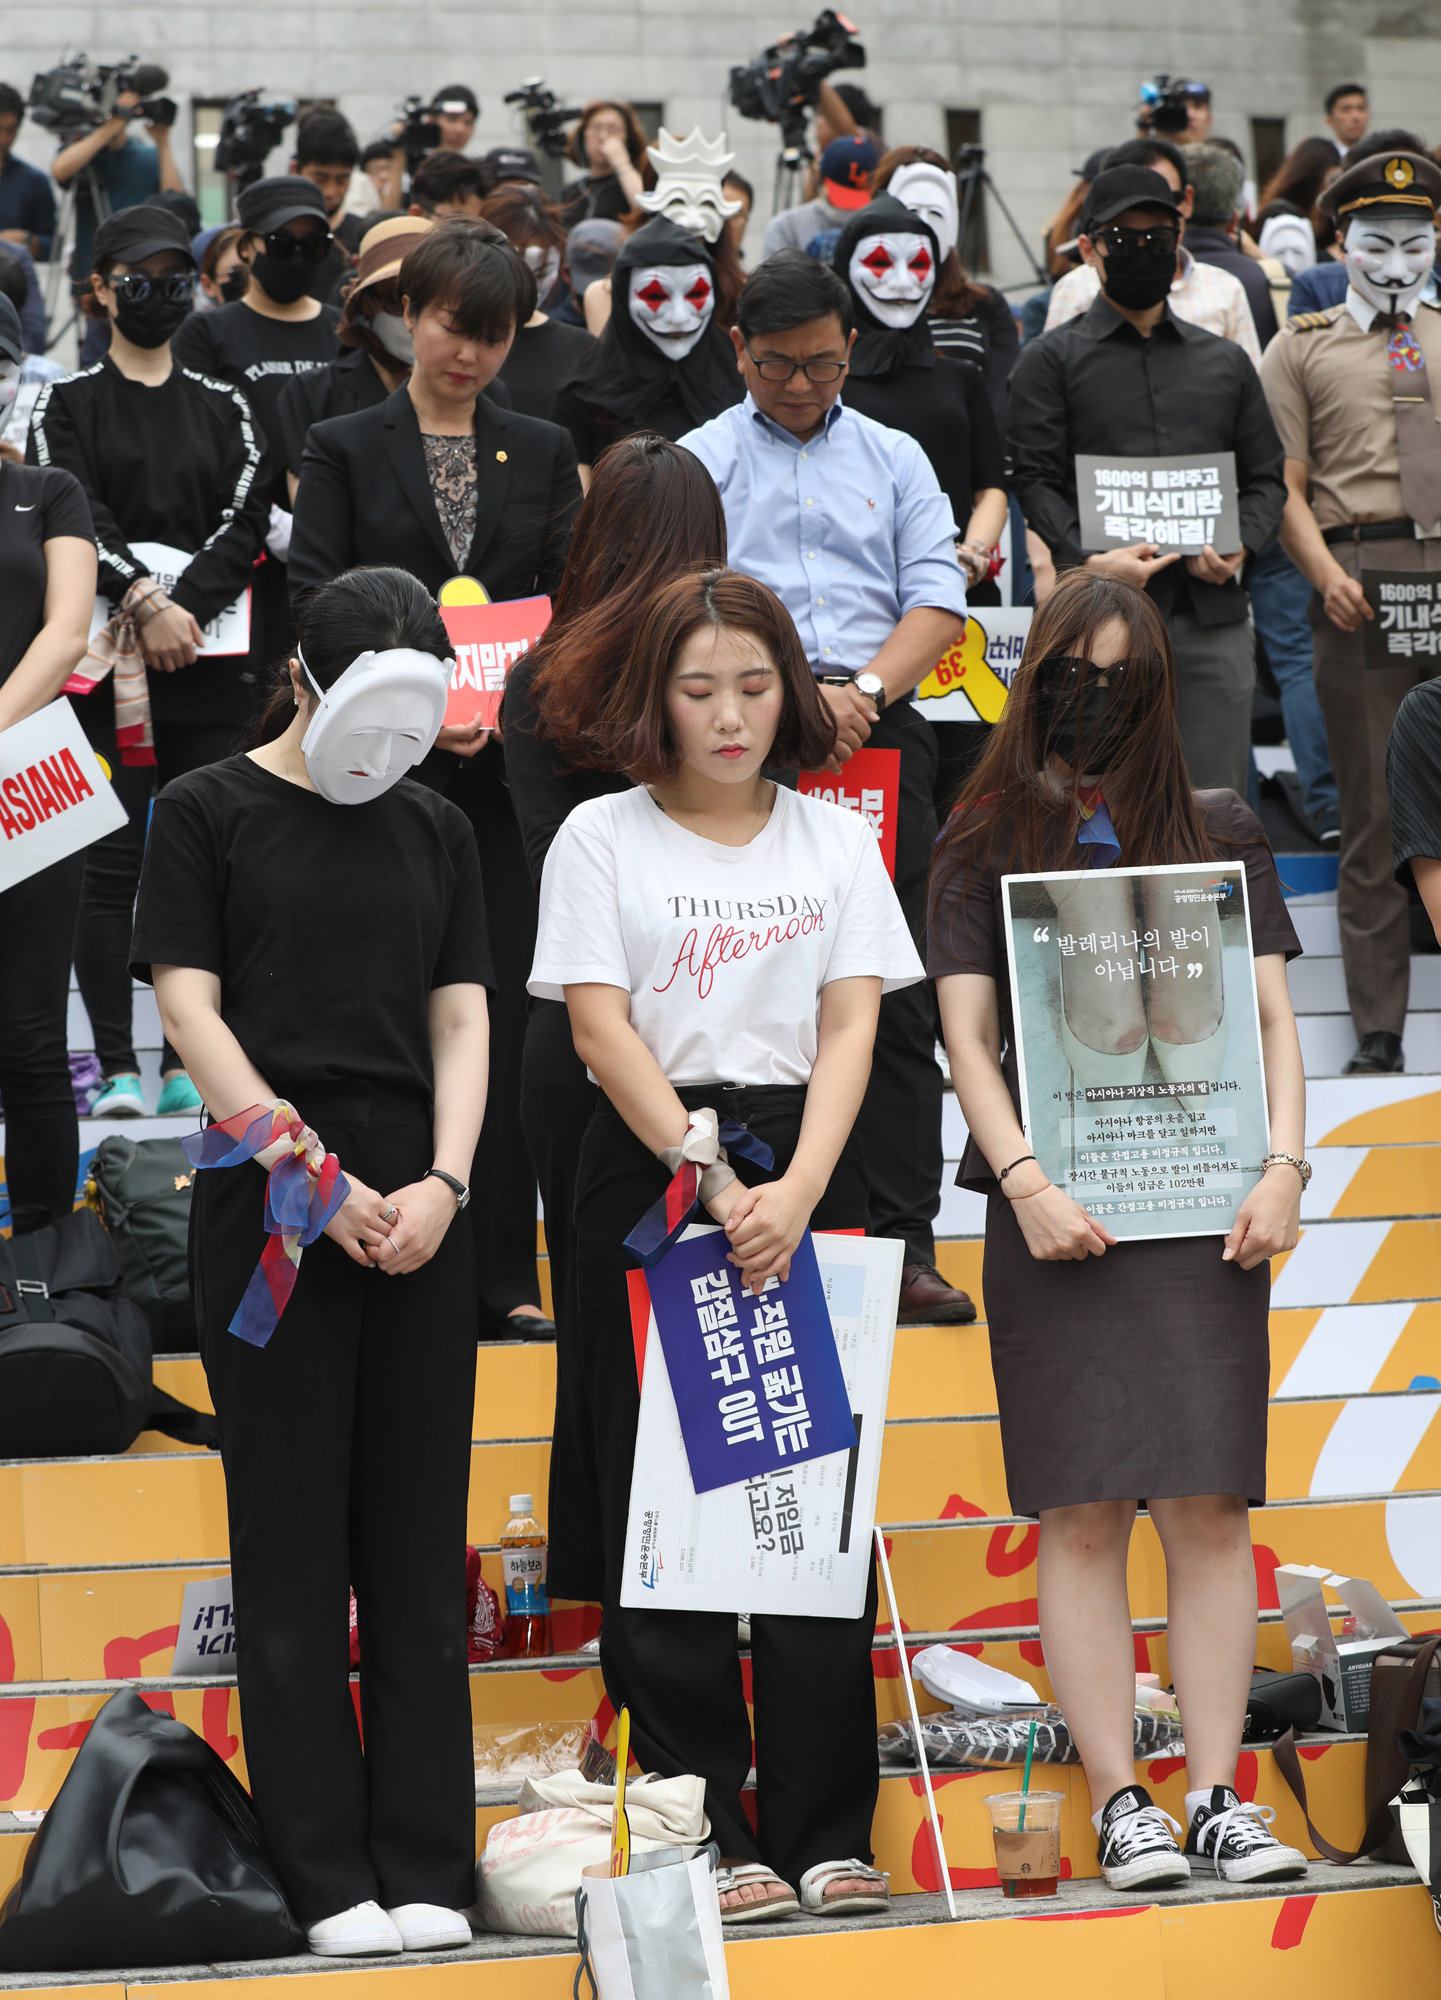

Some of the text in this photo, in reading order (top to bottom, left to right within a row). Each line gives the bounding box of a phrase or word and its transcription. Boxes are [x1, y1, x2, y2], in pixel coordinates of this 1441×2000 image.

[1094, 468, 1148, 489] 1600억
[1095, 488, 1223, 517] 기내식대란
[1104, 515, 1216, 545] 즉각해결!
[1379, 583, 1433, 602] 1600억
[1387, 630, 1441, 657] 즉각
[0, 747, 95, 840] ASIANA
[667, 894, 828, 921] THURSDAY
[1056, 928, 1161, 957] 발레리나의
[1169, 926, 1210, 950] 발이
[652, 913, 826, 999] Afternoon
[1094, 955, 1180, 983] 아닙니다
[1052, 1080, 1241, 1103] 이 발은 아시아나 지상직 노동자의 발 입니다.
[1095, 1111, 1207, 1129] 아시아나 항공의 옷을 입고
[1086, 1125, 1217, 1143] 아시아나 마크를 달고 일하지만
[1080, 1144, 1224, 1164] 이들은 간접고용 비정규직 입니다.
[1068, 1160, 1240, 1182] 장시간 불규칙 노동으로 발이 비틀어져도
[1106, 1176, 1205, 1193] 이들의 임금은 102만원
[1086, 1195, 1230, 1215] 이들은 간접고용 비정규직 입니다.
[689, 1268, 765, 1446] 갑질삼구 OUT
[761, 1364, 813, 1457] 굶기는
[774, 1483, 805, 1556] 저임금
[510, 1559, 543, 1573] 하늘보리
[1347, 1662, 1373, 1671] ANYGUAR
